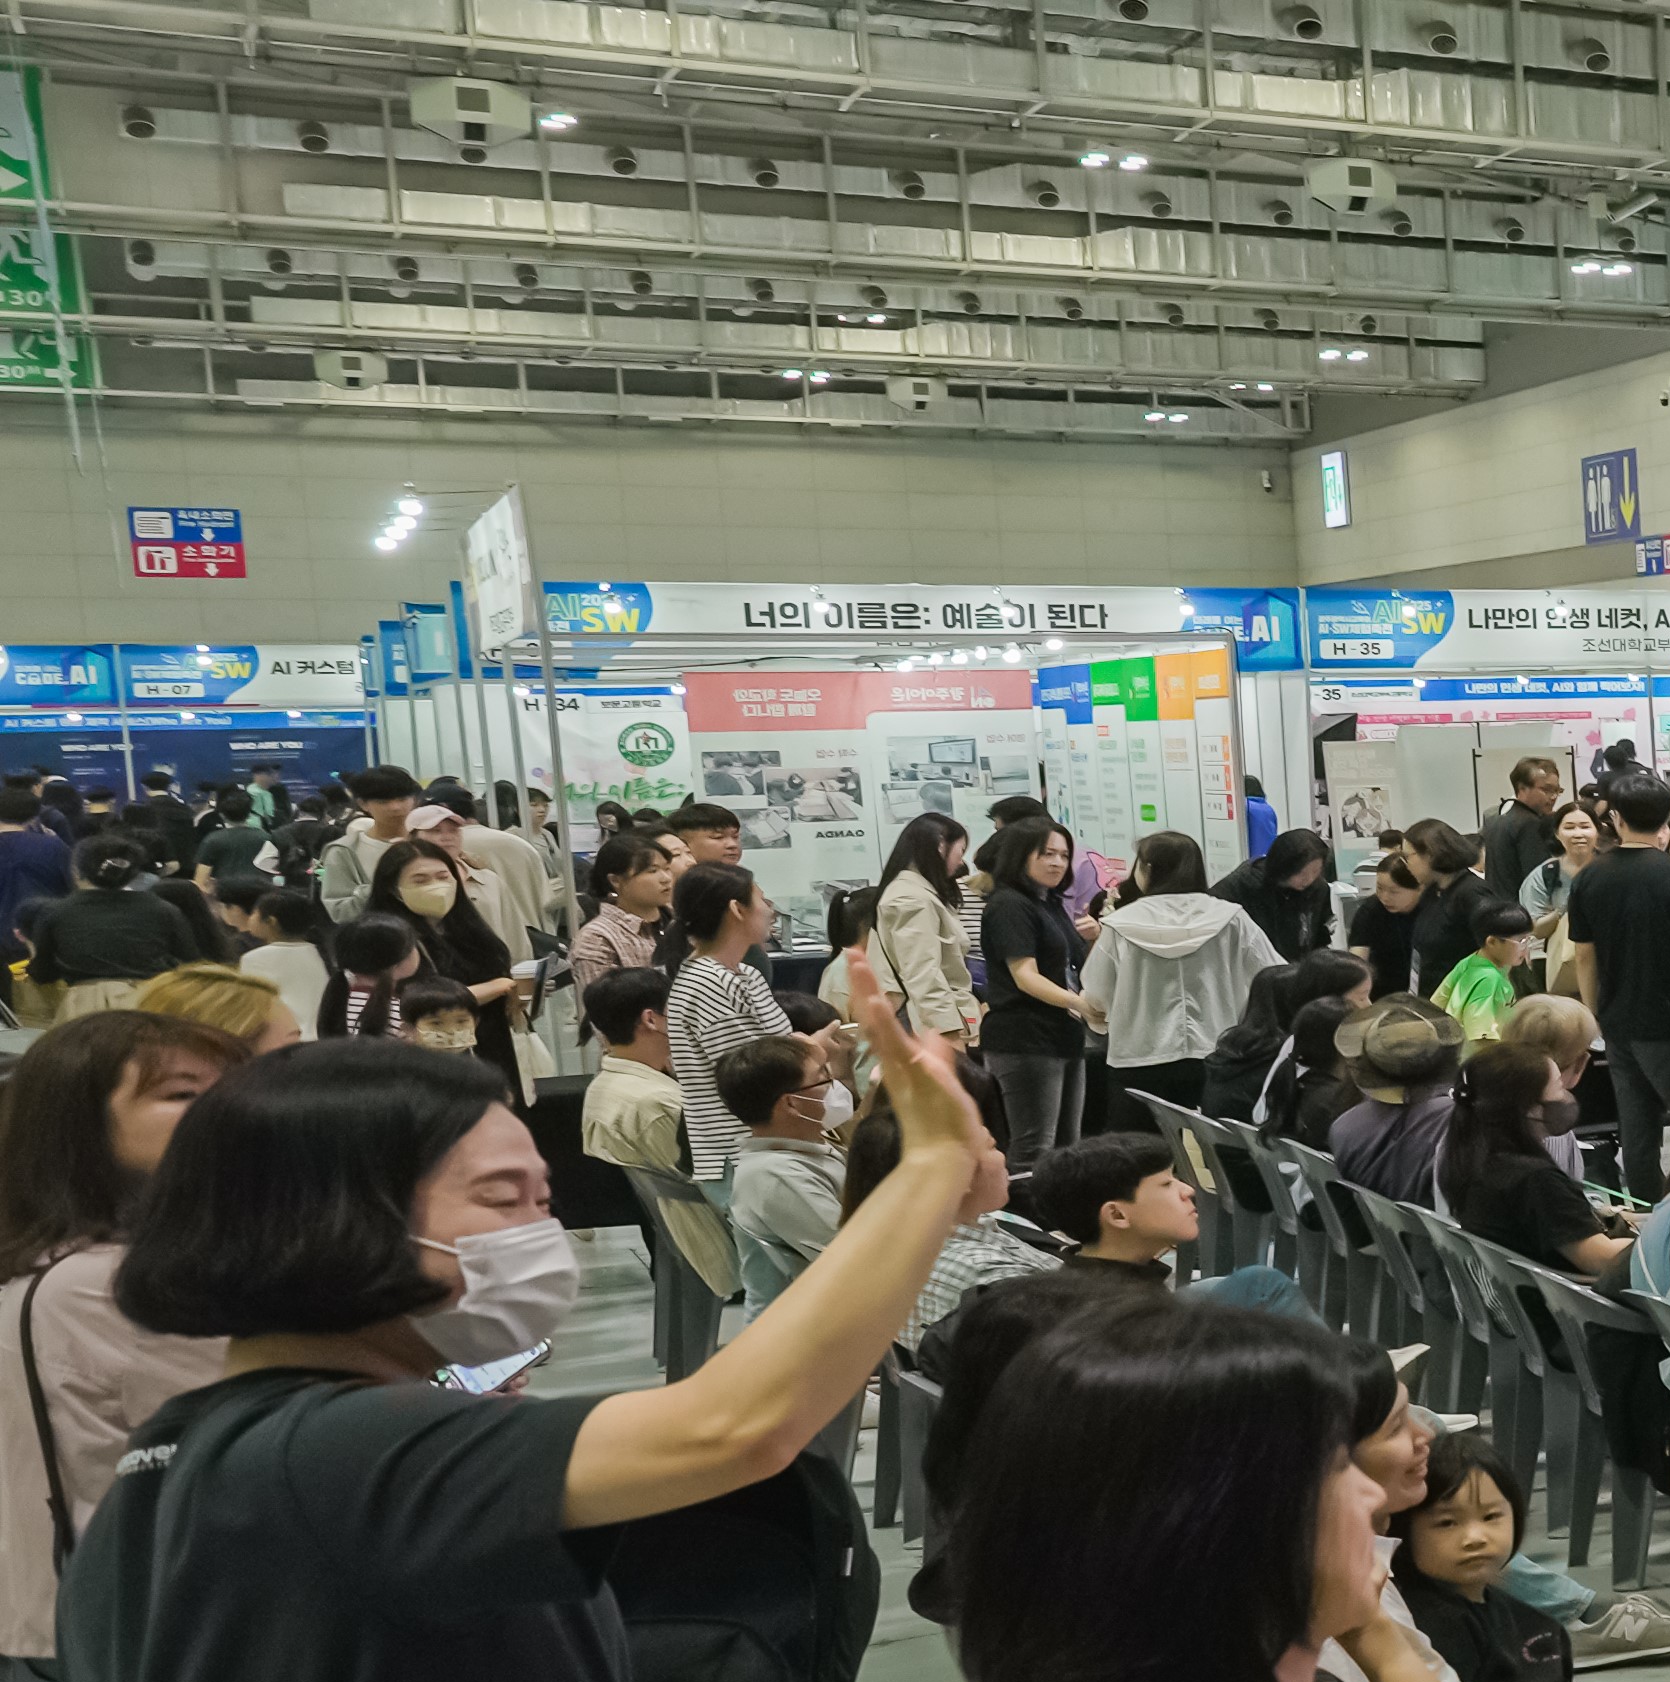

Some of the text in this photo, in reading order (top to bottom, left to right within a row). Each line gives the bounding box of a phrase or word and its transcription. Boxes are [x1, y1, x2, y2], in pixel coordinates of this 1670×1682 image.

[582, 608, 640, 633] SW
[743, 602, 1109, 630] 너의 이름은: 예술이 된다
[1402, 612, 1446, 635] SW
[1467, 608, 1538, 630] 나만의
[1545, 608, 1591, 630] 인생
[1597, 607, 1648, 632] 네컷,
[211, 660, 251, 680] SW
[270, 659, 355, 676] AI 커스텀
